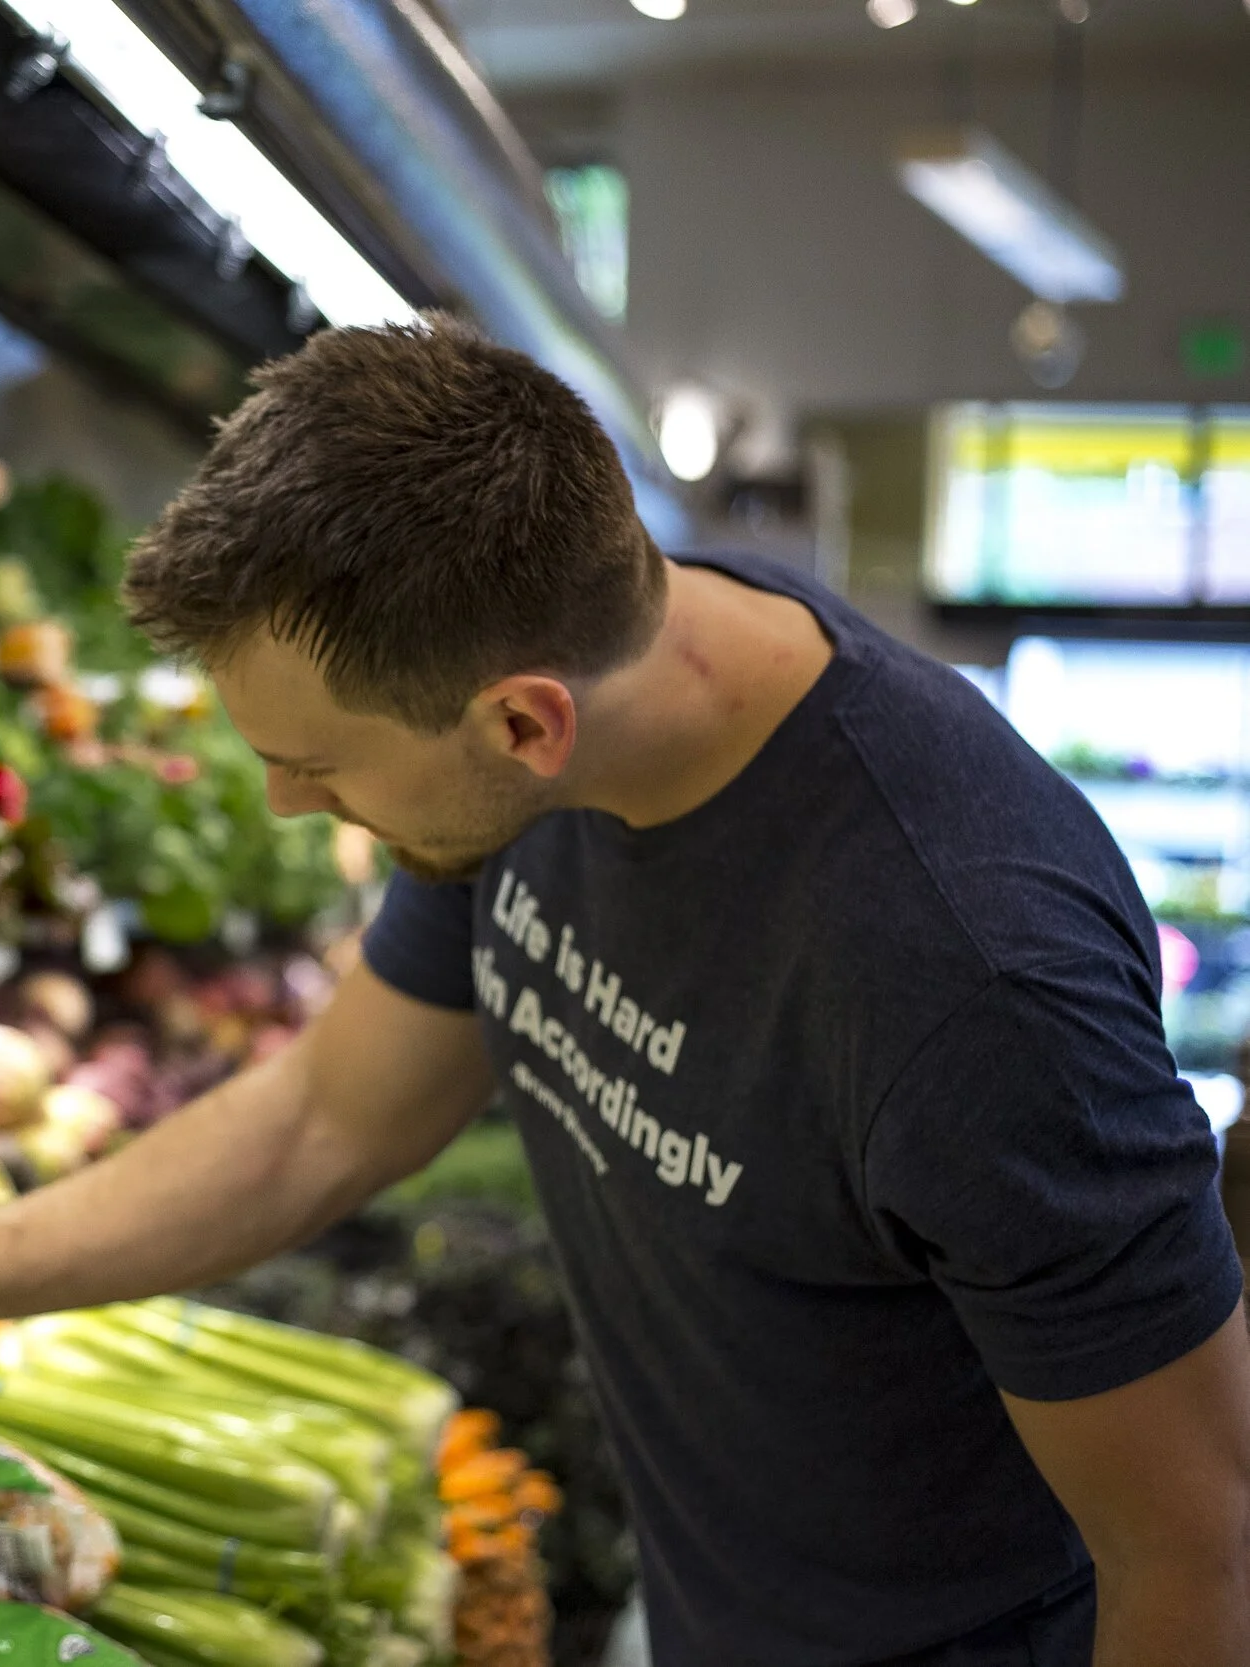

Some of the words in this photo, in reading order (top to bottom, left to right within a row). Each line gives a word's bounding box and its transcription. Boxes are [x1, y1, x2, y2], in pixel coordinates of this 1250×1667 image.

[491, 868, 550, 963] Life
[555, 923, 586, 994] is
[584, 959, 687, 1075] Hard
[509, 986, 743, 1205] Accordingly
